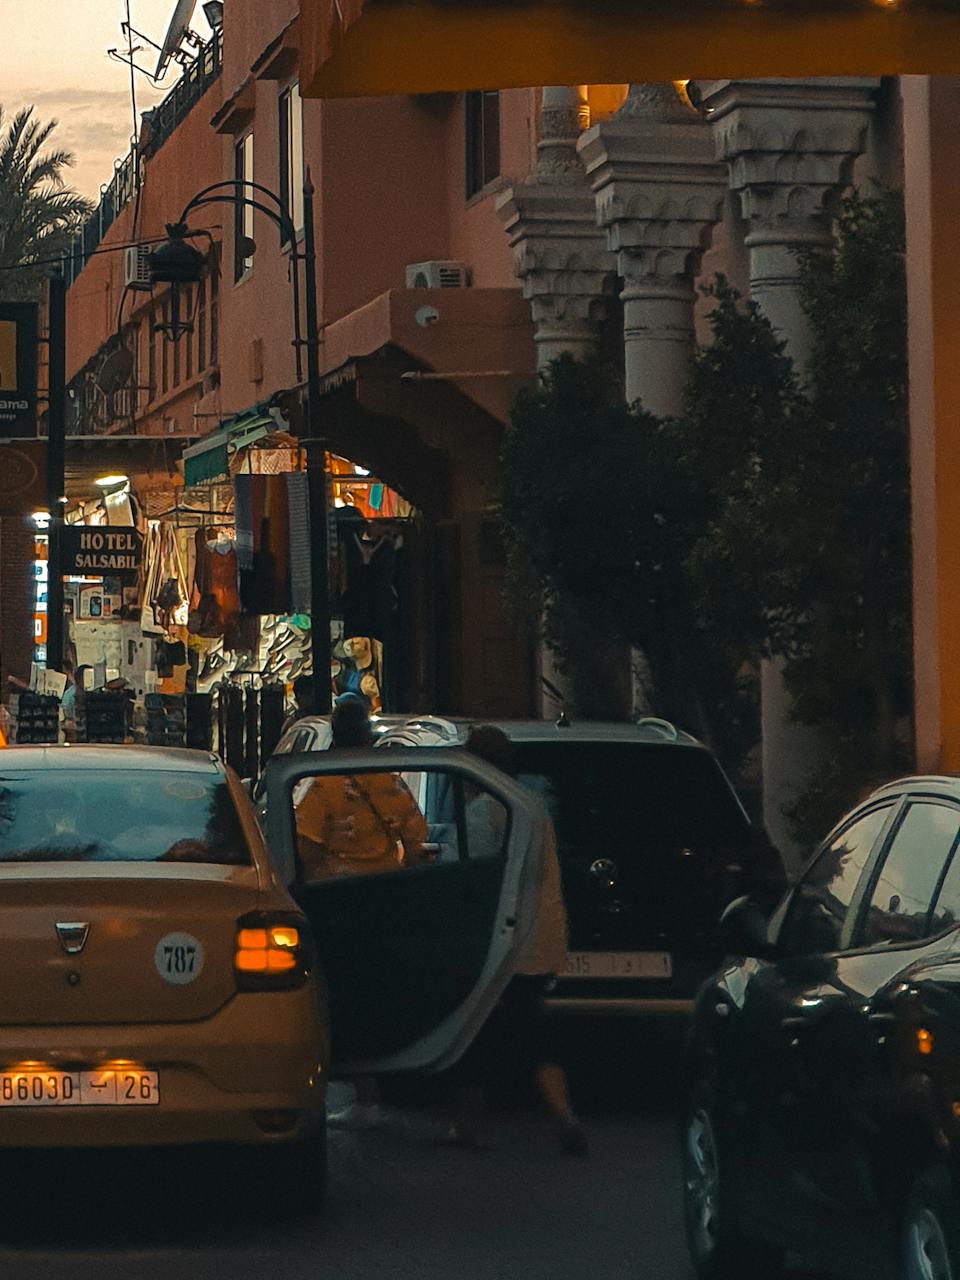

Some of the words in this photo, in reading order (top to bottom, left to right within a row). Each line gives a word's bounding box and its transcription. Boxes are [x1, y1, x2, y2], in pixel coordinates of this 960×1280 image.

[80, 532, 136, 550] HOTEL
[75, 553, 139, 569] SALSABIL
[163, 945, 196, 973] 787
[2, 1076, 73, 1101] 86030
[124, 1075, 151, 1099] 26
